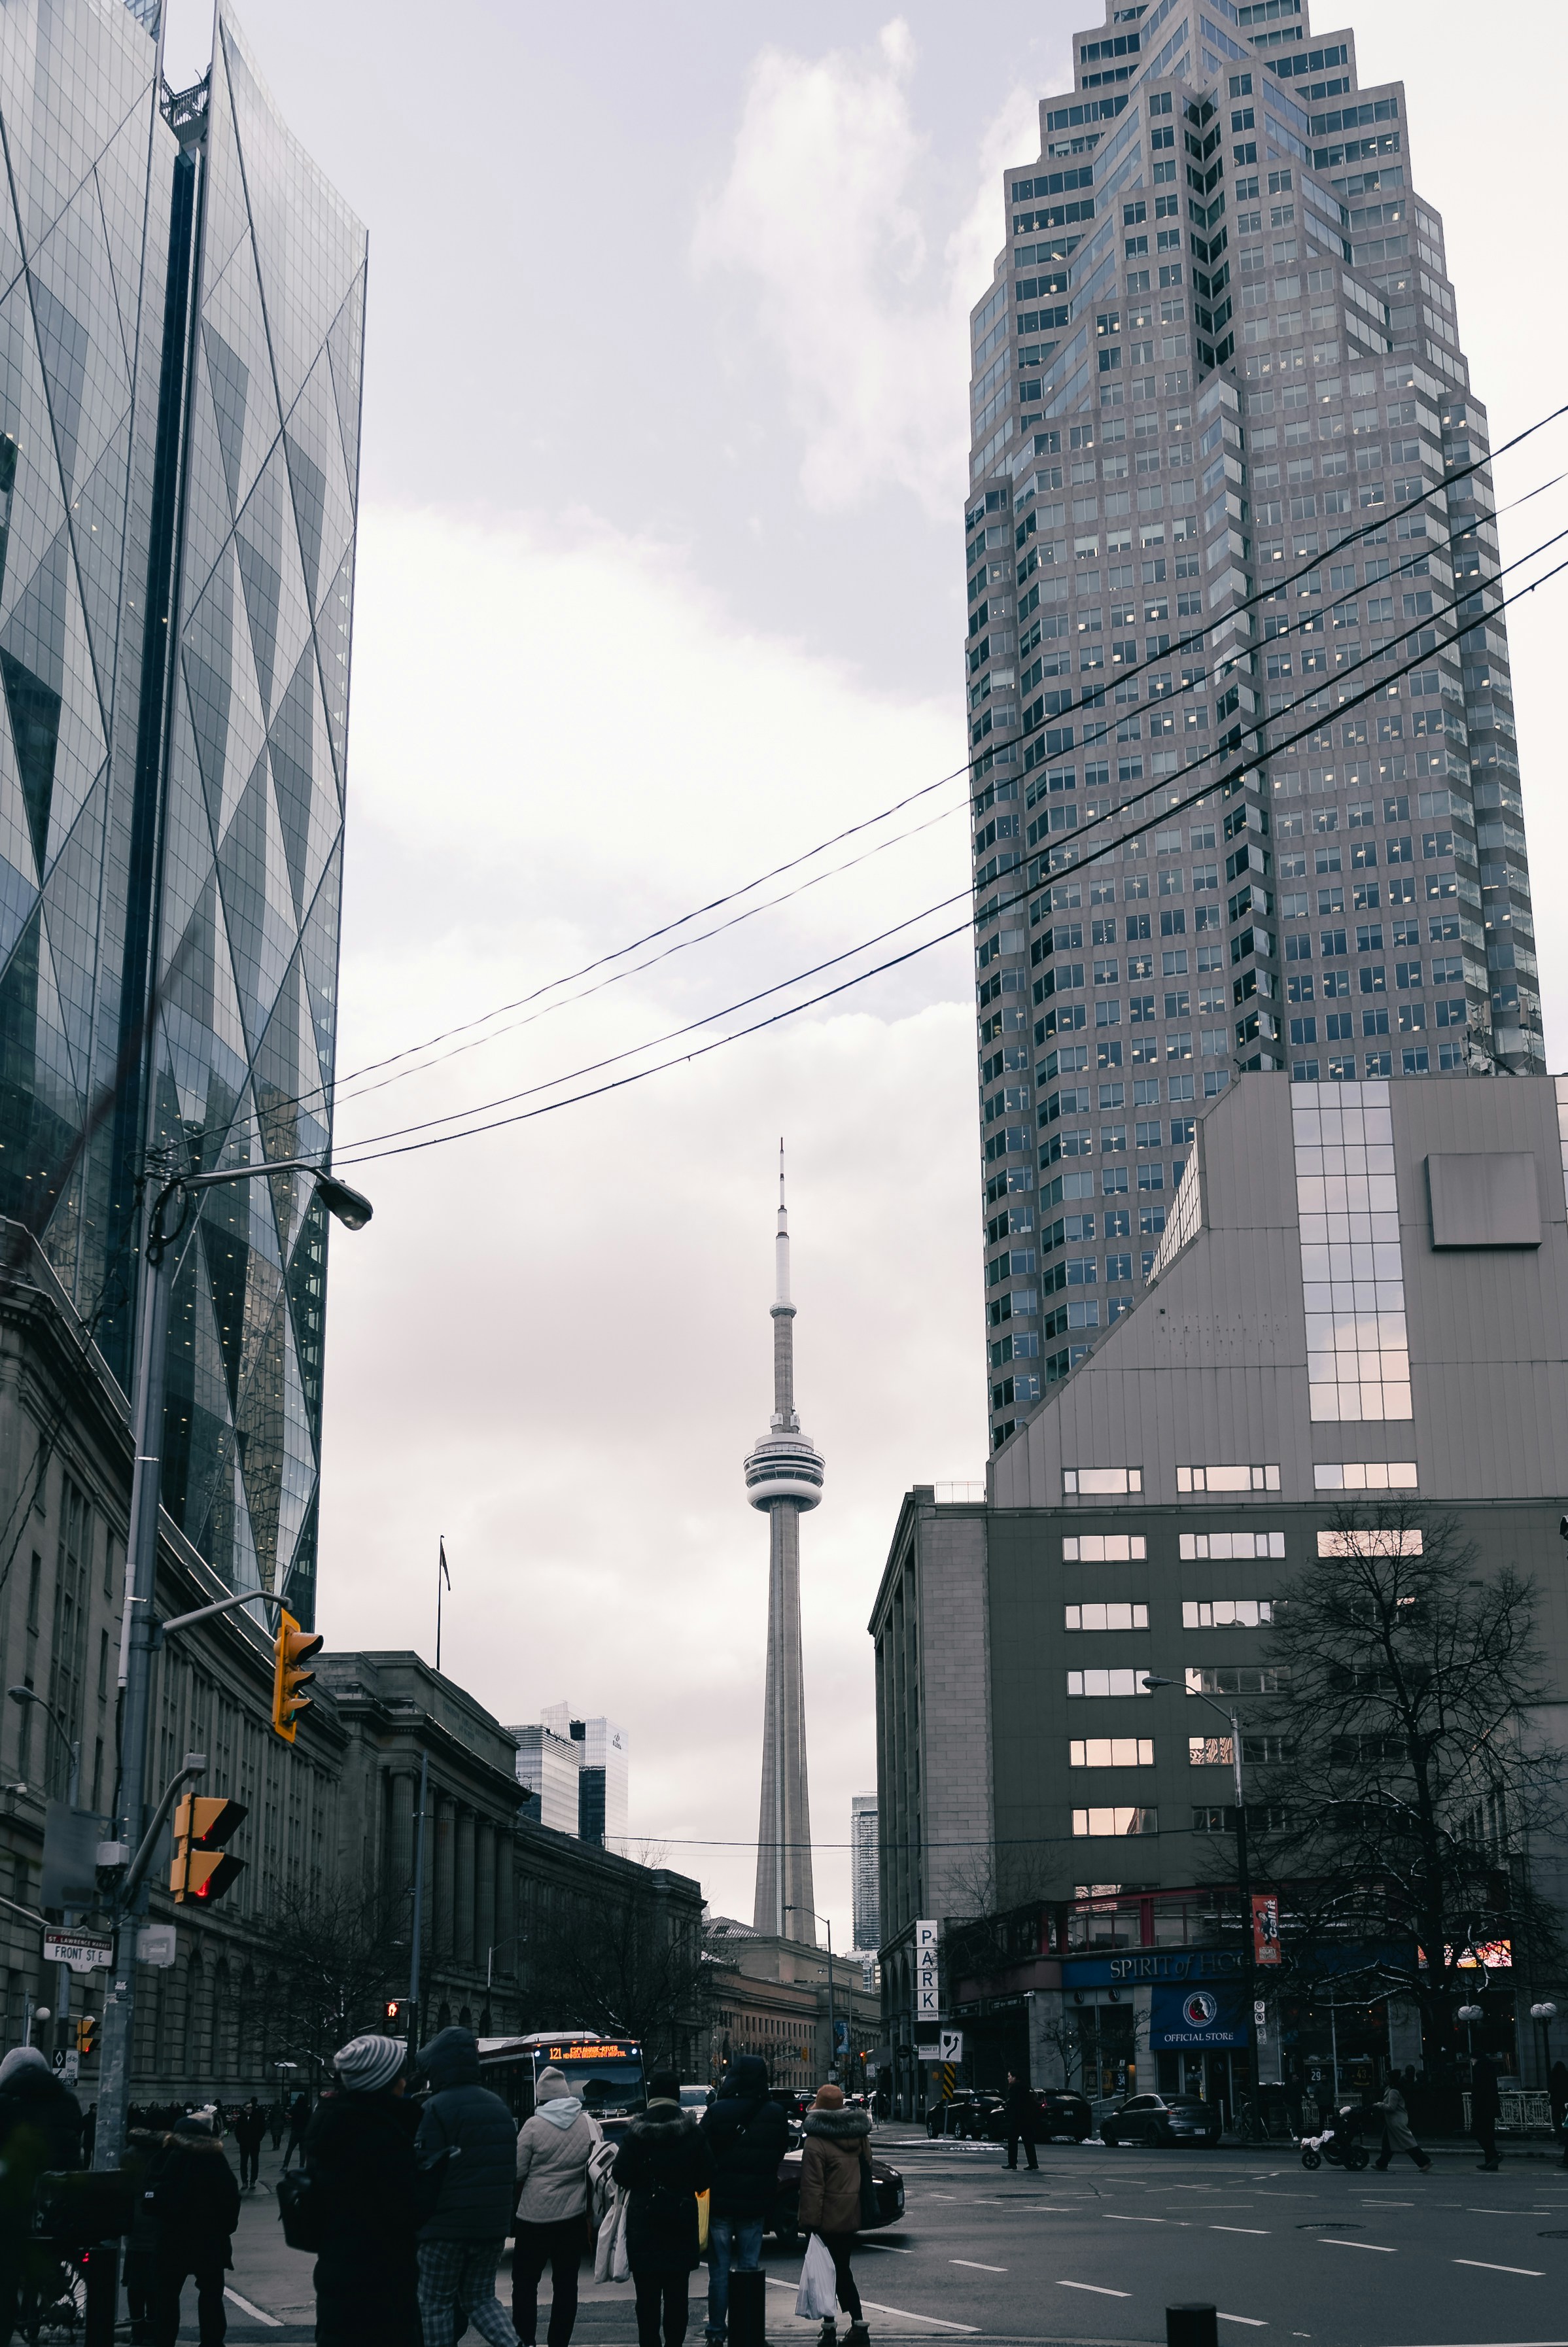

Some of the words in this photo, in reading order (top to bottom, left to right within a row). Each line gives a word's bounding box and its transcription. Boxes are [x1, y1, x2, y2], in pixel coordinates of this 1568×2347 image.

[1267, 1900, 1276, 1909] it
[61, 1938, 90, 1947] LAWRENCE
[92, 1940, 110, 1949] MARKET
[55, 1945, 82, 1960] FRONT
[922, 1930, 934, 2008] PARK
[1110, 1956, 1172, 1979] SPIRIT
[1175, 1955, 1195, 1981] of
[1164, 2033, 1204, 2042] OFFICIAL
[1205, 2032, 1234, 2040] STORE
[549, 2047, 562, 2060] 121
[570, 2045, 618, 2055] ESPLANADE-RIVER
[1118, 2076, 1125, 2085] 34
[1311, 2071, 1321, 2081] 29
[1357, 2069, 1367, 2079] 43
